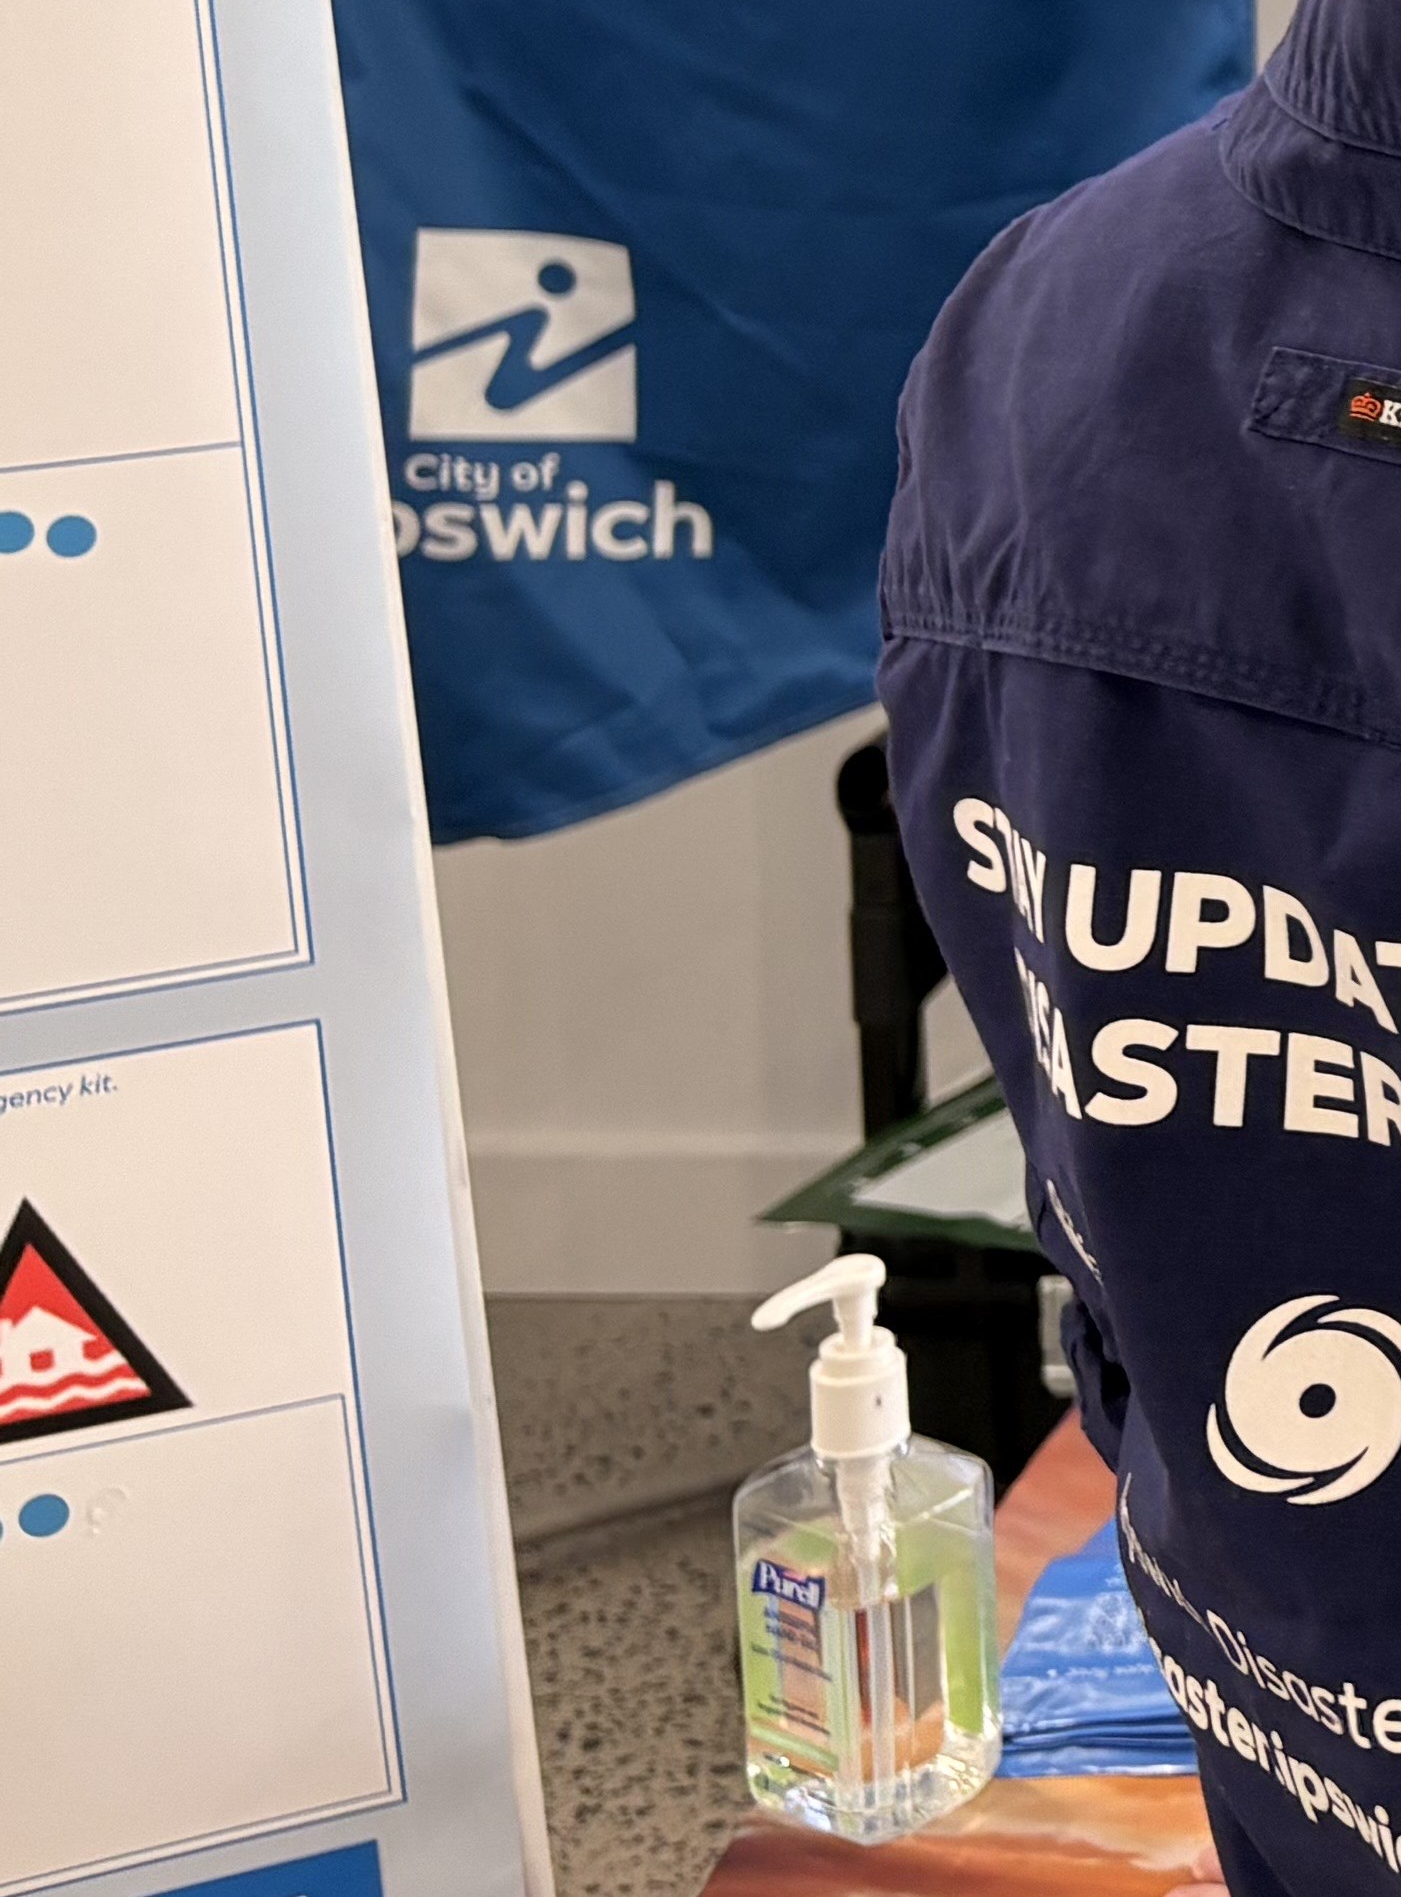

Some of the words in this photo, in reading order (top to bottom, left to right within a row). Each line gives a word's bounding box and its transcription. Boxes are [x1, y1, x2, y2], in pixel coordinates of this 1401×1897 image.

[405, 453, 499, 500] City
[511, 453, 560, 492] of
[393, 479, 714, 563] swich
[80, 1073, 118, 1097] kit.
